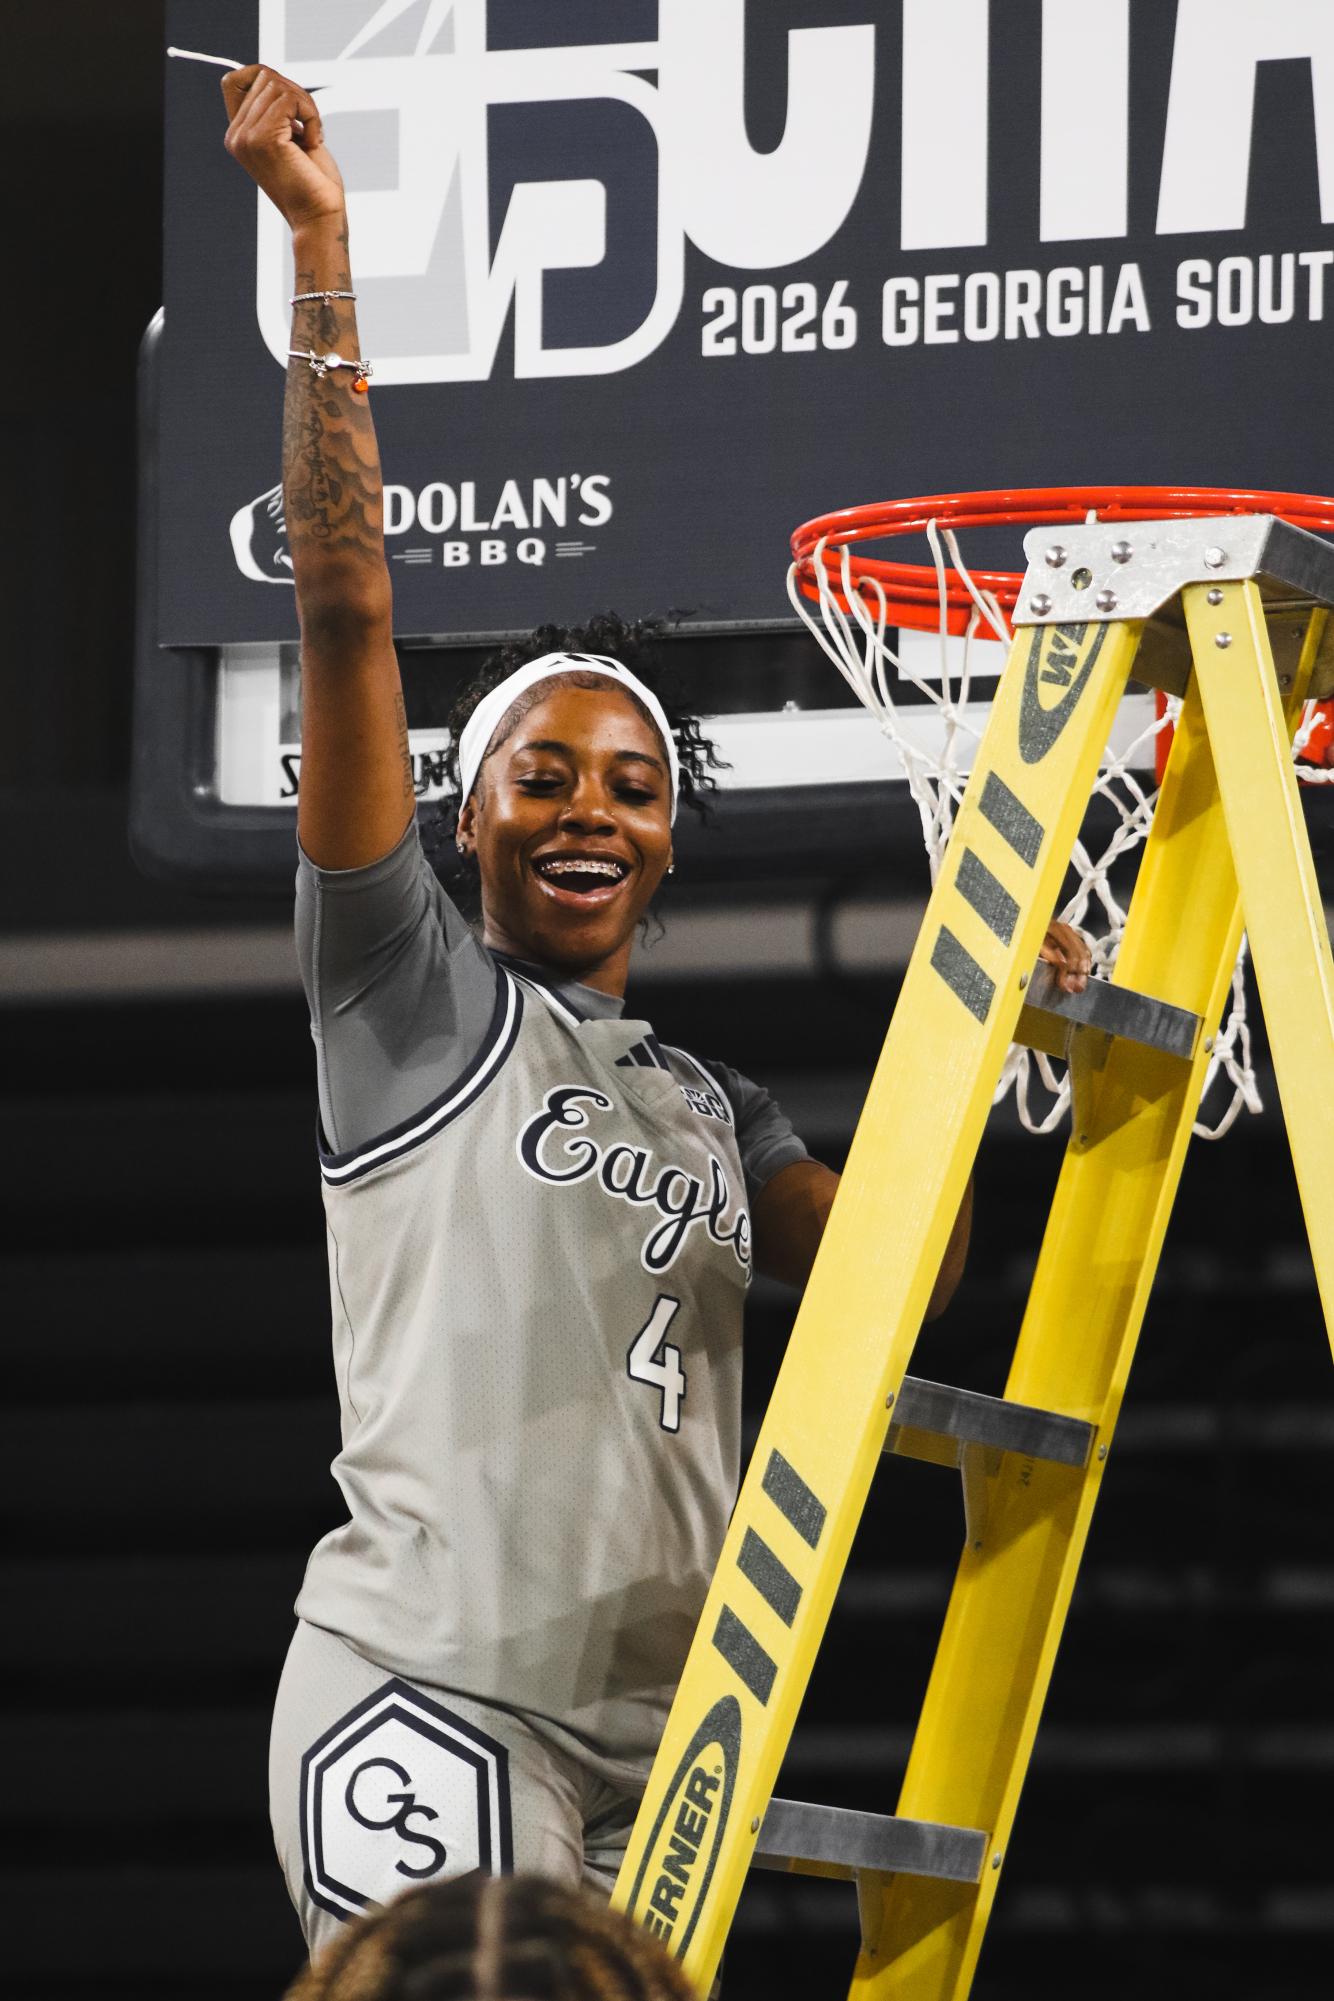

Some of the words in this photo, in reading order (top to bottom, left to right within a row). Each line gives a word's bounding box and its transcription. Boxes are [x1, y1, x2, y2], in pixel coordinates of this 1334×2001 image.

[701, 280, 857, 357] 2026
[882, 262, 1151, 347] GEORGIA
[383, 474, 613, 536] DOLAN'S
[443, 537, 546, 567] BBQ
[516, 1085, 753, 1289] Eagle
[626, 1294, 686, 1433] 4
[345, 1757, 447, 1879] GS
[643, 1766, 721, 1942] ERNER
